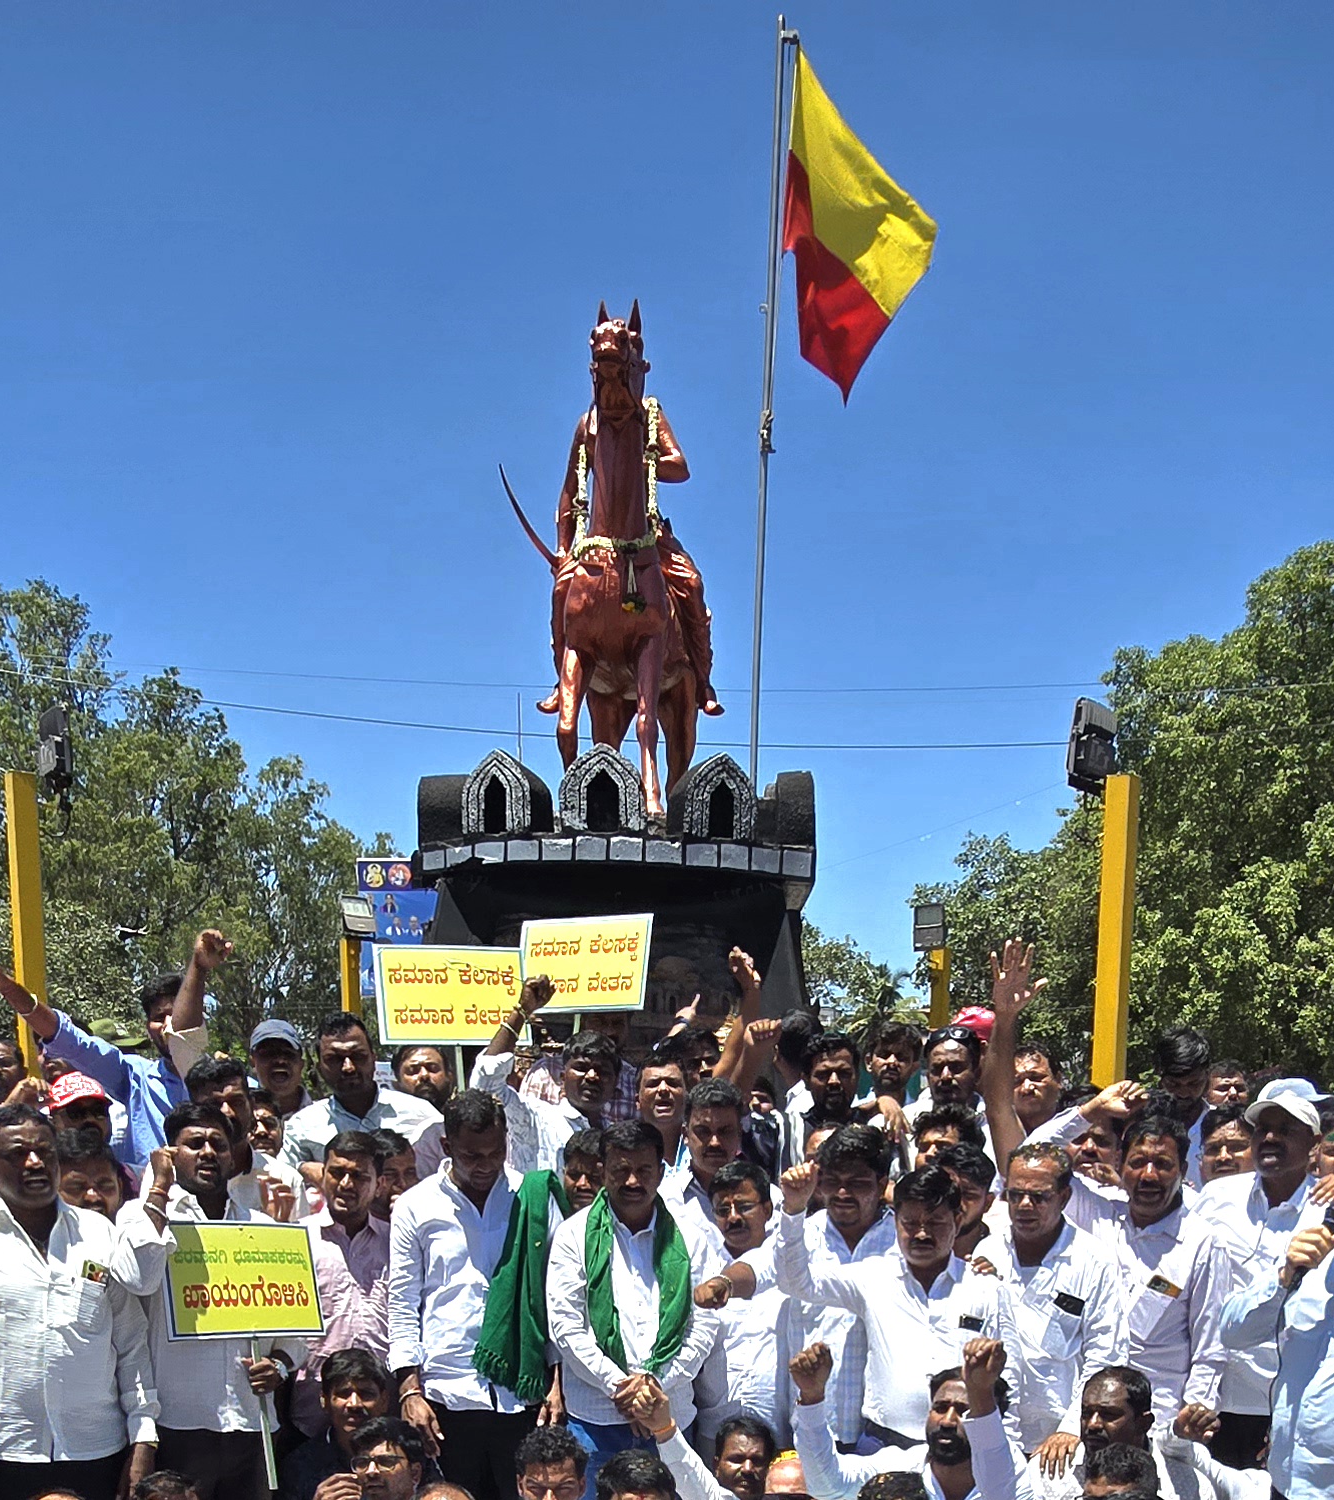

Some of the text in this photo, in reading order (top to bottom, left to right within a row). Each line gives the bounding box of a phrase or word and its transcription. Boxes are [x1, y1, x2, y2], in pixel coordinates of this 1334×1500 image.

[530, 932, 639, 962] ಸಮಾನ ಕೆಲಸಕ್ಕೆ
[387, 963, 516, 996] ಸಮಾನ ಕೆಲಸಕ್ಕೆ
[587, 971, 634, 993] ವೇತನ
[393, 1003, 455, 1026] ಸಮಾನ
[182, 1275, 310, 1309] ಖಾಯಂಗೊಳಿಸಿ
